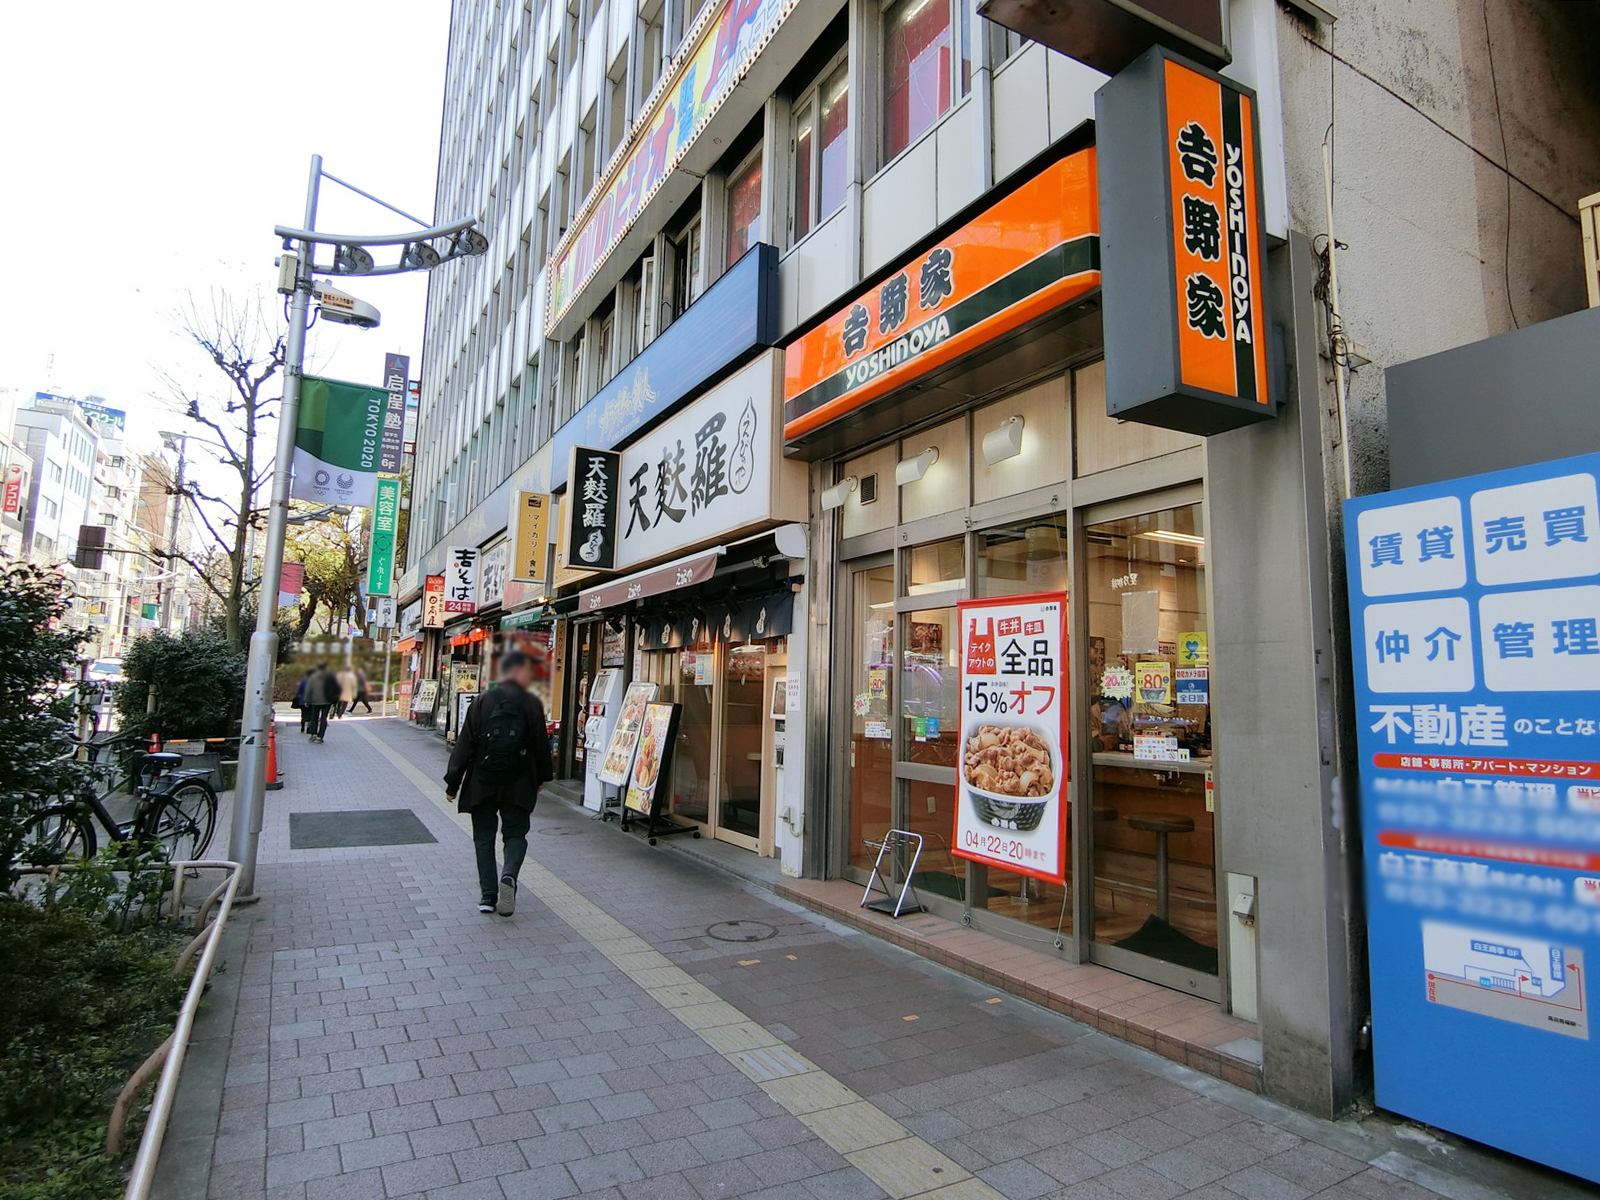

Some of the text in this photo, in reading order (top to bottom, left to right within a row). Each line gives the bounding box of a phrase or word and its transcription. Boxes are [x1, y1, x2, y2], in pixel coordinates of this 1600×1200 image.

[1176, 121, 1227, 340] 吉野家
[1226, 143, 1251, 344] YOSHINOYA
[842, 248, 954, 358] 吉野家
[846, 315, 950, 390] YOSHINOYA
[360, 398, 381, 468] TOKYO 2020
[381, 458, 396, 470] 6F
[624, 411, 729, 540] 天麩羅
[376, 485, 396, 532] 美容室
[581, 456, 609, 529] 天麩羅
[528, 513, 540, 578] マイカリー食堂
[1369, 525, 1455, 568] 賃貸
[1483, 506, 1589, 555] 売買
[451, 549, 476, 602] 吉そば
[448, 602, 462, 611] 24
[970, 642, 991, 653] テイク
[1001, 639, 1053, 676] 全品
[1375, 626, 1462, 664] 仲介
[1492, 617, 1600, 660] 管理
[968, 658, 994, 668] アウトの
[1143, 673, 1162, 689] 80
[965, 682, 1008, 714] 15%
[1009, 681, 1056, 715] オフ
[1369, 704, 1600, 746] 不動産 のことな
